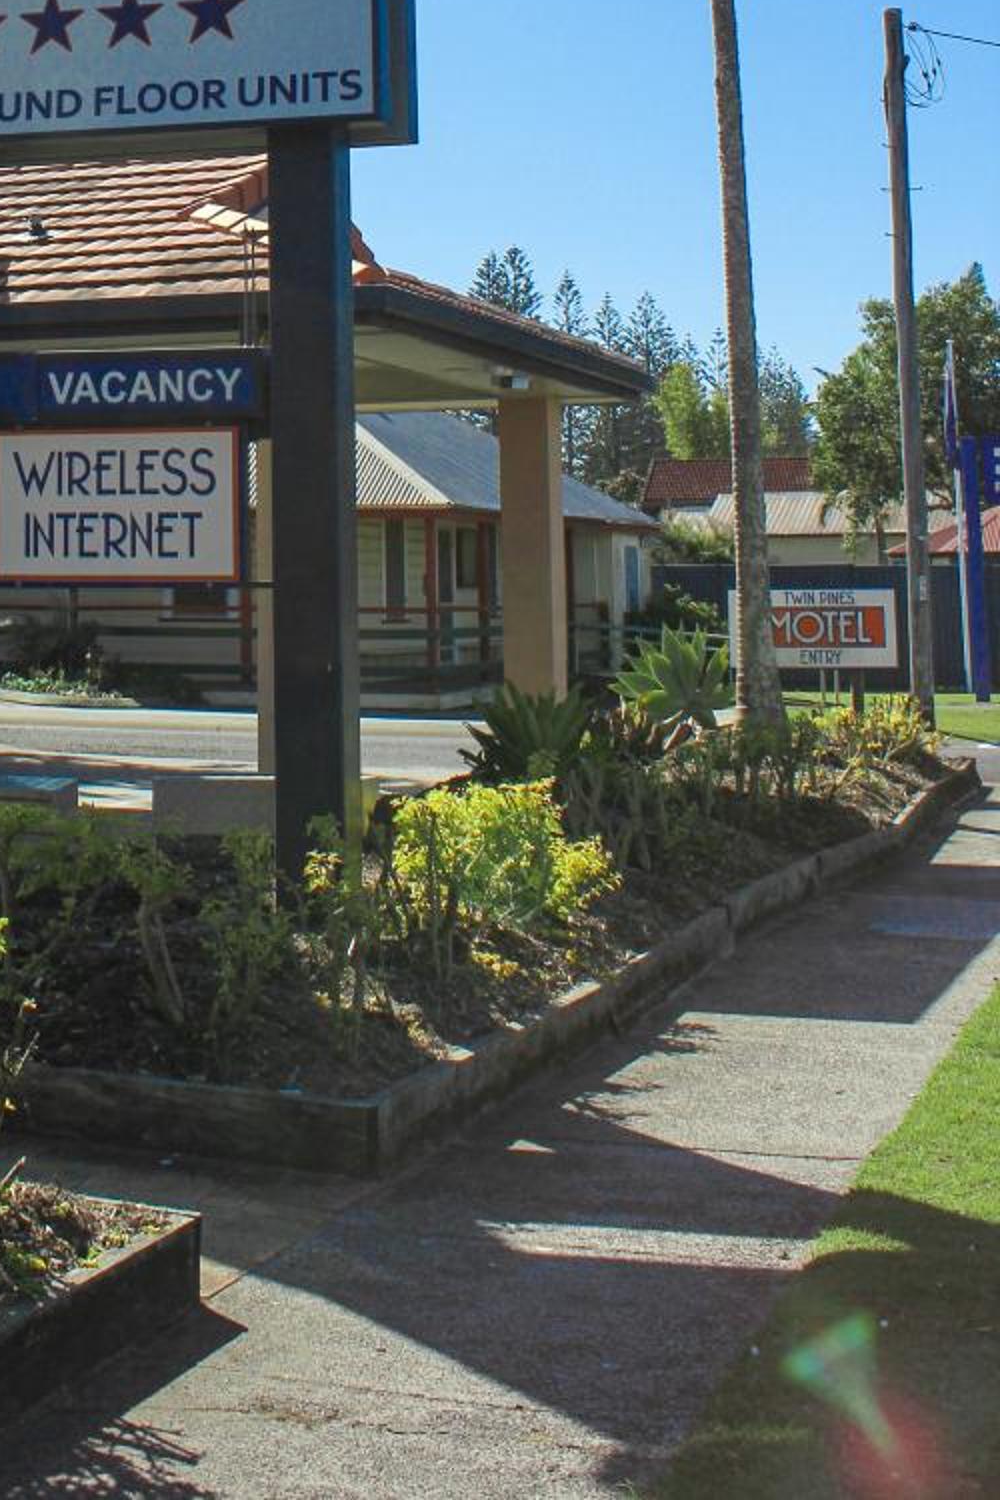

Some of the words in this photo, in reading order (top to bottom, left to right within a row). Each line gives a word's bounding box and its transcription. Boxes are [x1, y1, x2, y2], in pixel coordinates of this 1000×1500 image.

[92, 78, 227, 117] FLOOR
[237, 69, 363, 107] UNITS
[49, 368, 242, 404] VACANCY
[12, 448, 217, 497] WIRELESS
[24, 511, 202, 558] INTERNET
[784, 592, 815, 605] TWIN
[819, 592, 856, 605] PINES
[769, 610, 872, 644] MOTEL
[800, 650, 841, 665] ENTRY
